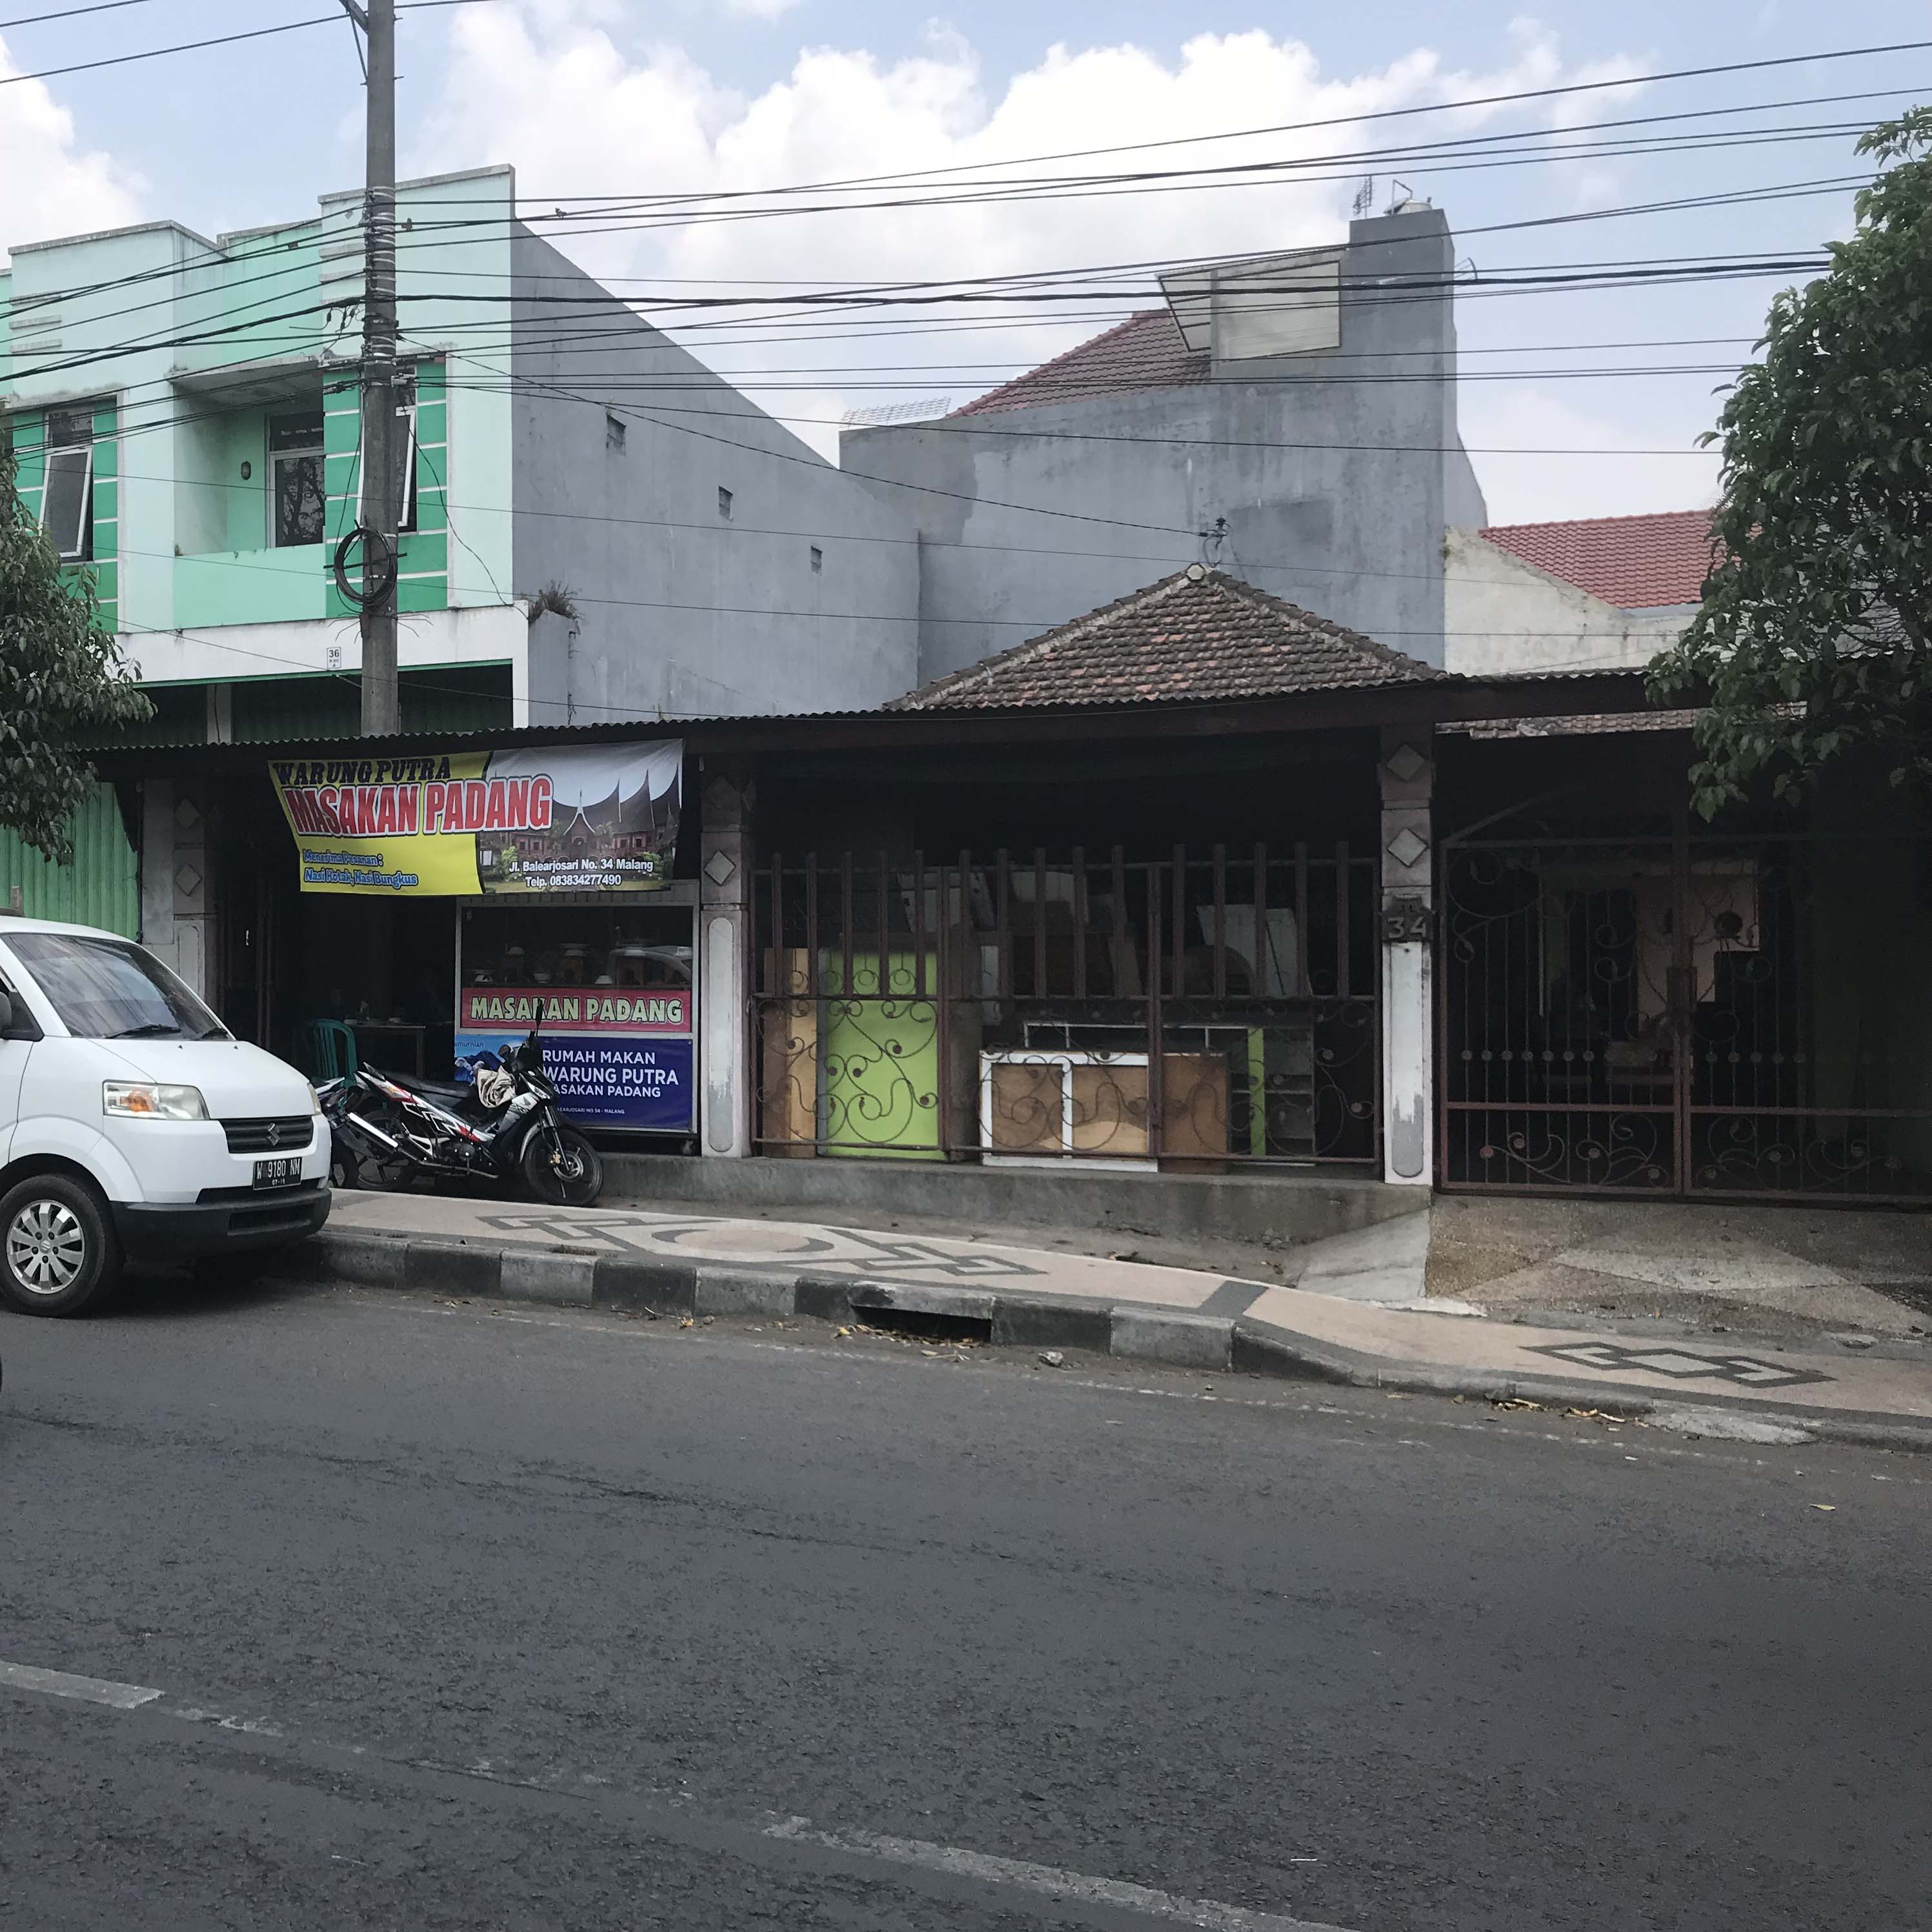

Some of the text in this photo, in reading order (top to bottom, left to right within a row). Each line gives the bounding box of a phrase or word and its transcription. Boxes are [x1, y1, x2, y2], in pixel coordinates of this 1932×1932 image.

[329, 649, 339, 658] 36
[272, 756, 451, 785] WARUNG PUTRA
[281, 774, 554, 837] MASAKAN PADANG
[303, 850, 343, 863] Menerima
[523, 859, 579, 873] Balearjosari
[581, 859, 598, 870] No.
[600, 859, 614, 869] 34
[616, 859, 654, 872] Malang
[305, 868, 419, 889] Nasi Kotak, Nasi Bungkus
[525, 874, 621, 889] Telp. 083834277490
[1387, 916, 1426, 938] 34
[470, 996, 683, 1023] MASAKAN PADANG
[542, 1049, 656, 1065] RUMAH MAKAN
[543, 1065, 679, 1085] WARUNG PUTRA
[553, 1083, 661, 1098] ASAKAN PADANG
[257, 1158, 301, 1180] W 9180 NM
